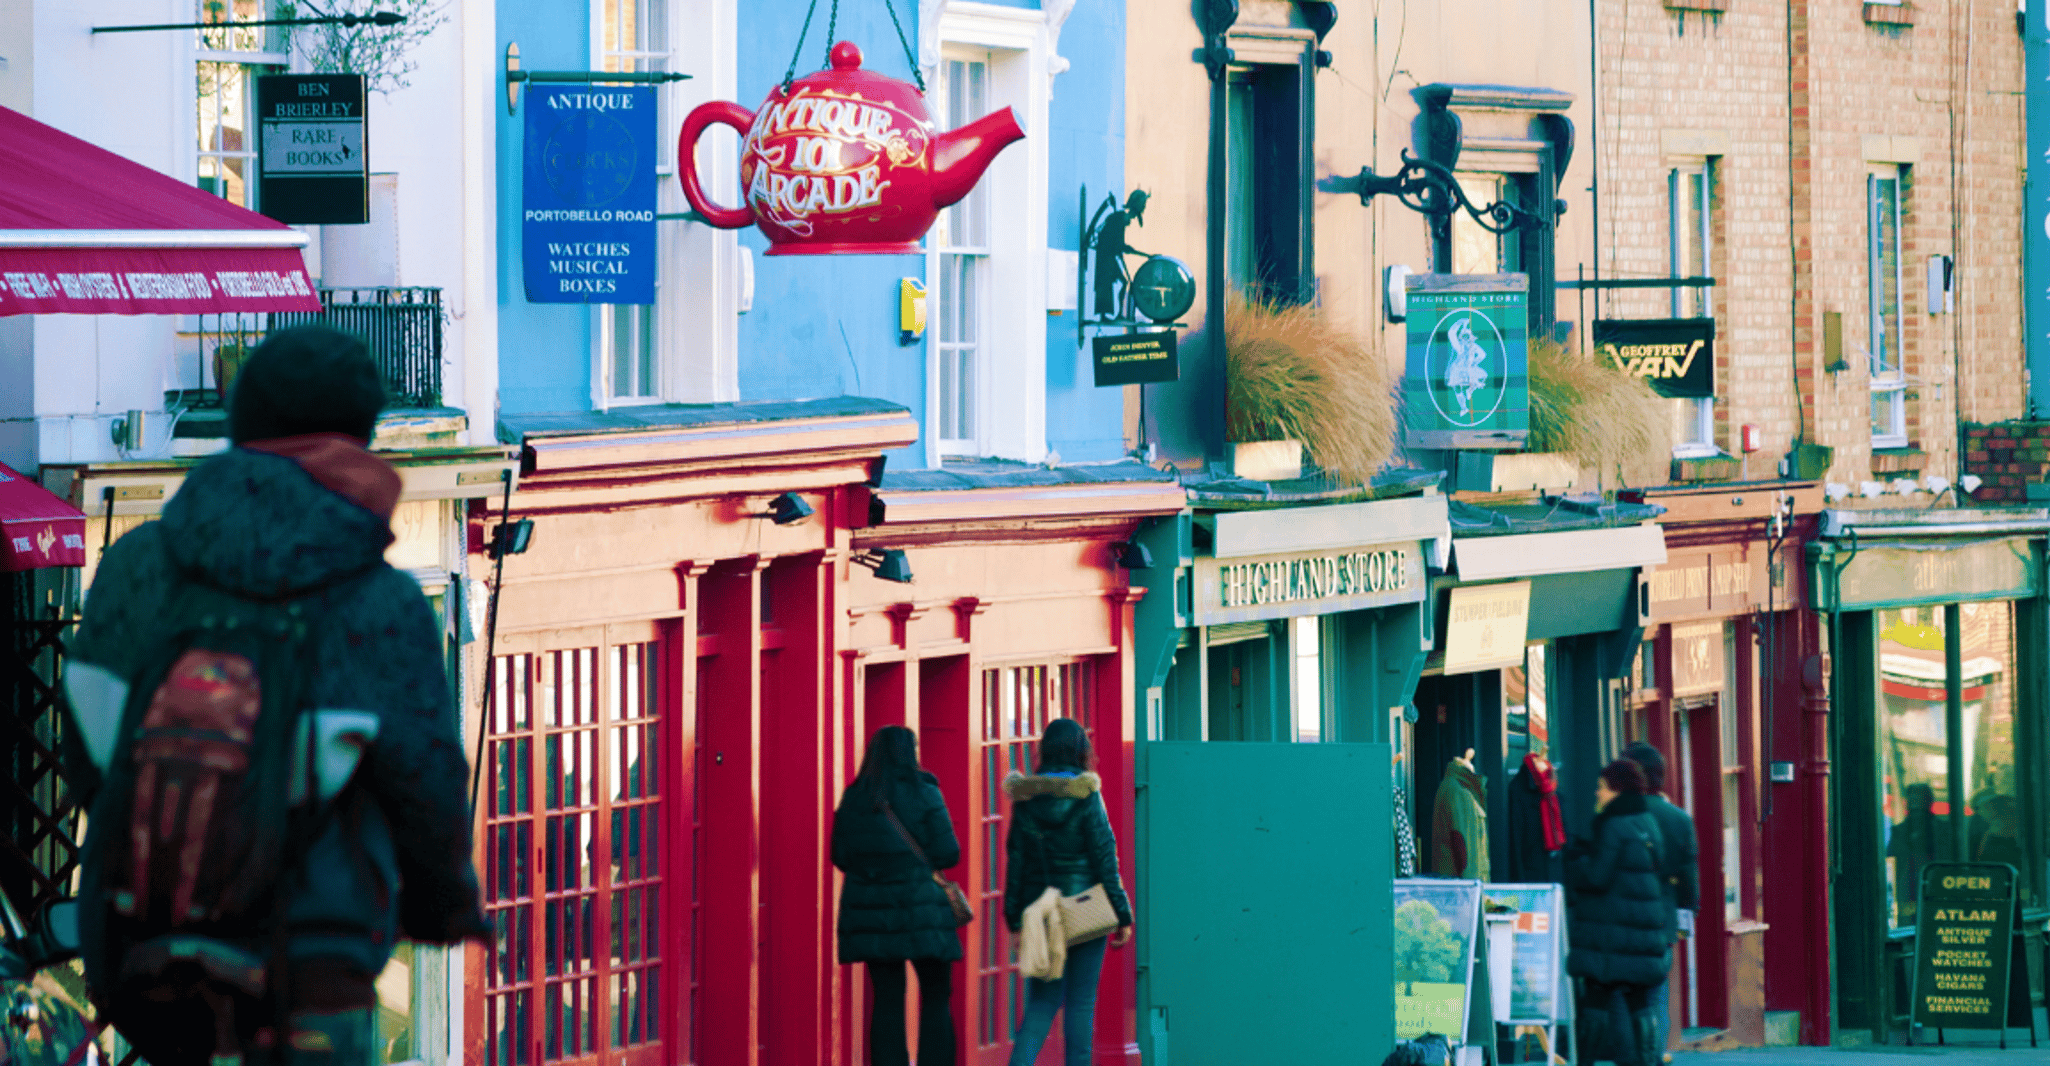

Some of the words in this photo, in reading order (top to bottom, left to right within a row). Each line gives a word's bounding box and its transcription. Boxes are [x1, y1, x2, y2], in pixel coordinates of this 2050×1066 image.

[297, 83, 330, 96] BEN
[275, 102, 353, 116] BRIERLEY
[547, 93, 634, 112] ANTIQUE
[744, 97, 900, 148] ANTIQUE
[292, 129, 337, 144] RARE
[287, 151, 344, 166] BOOKS
[748, 160, 890, 213] ARCADE
[525, 209, 612, 222] PORTOBELLO
[615, 209, 653, 222] ROAD
[547, 242, 631, 257] WATCHES
[548, 260, 629, 275] MUSICAL
[559, 278, 616, 293] BOXES
[1481, 295, 1520, 303] STORE
[1620, 344, 1688, 357] GEOFFREY
[1604, 339, 1704, 378] VAN
[1224, 556, 1338, 607] HIGHLAND
[1342, 549, 1408, 596] STORE
[1942, 876, 1991, 890] OPEN
[1934, 909, 1997, 922] ATLAM
[1936, 927, 1992, 937] ANTIQUE
[1941, 936, 1986, 945] SILVER
[1936, 950, 1988, 959] POCKET
[1932, 958, 1993, 968] WATCHES
[1934, 972, 1986, 982] HAVANA
[1936, 981, 1984, 990] CIGARS
[1925, 996, 1992, 1006] FINANCIAL
[1928, 1004, 1989, 1014] SERVICES
